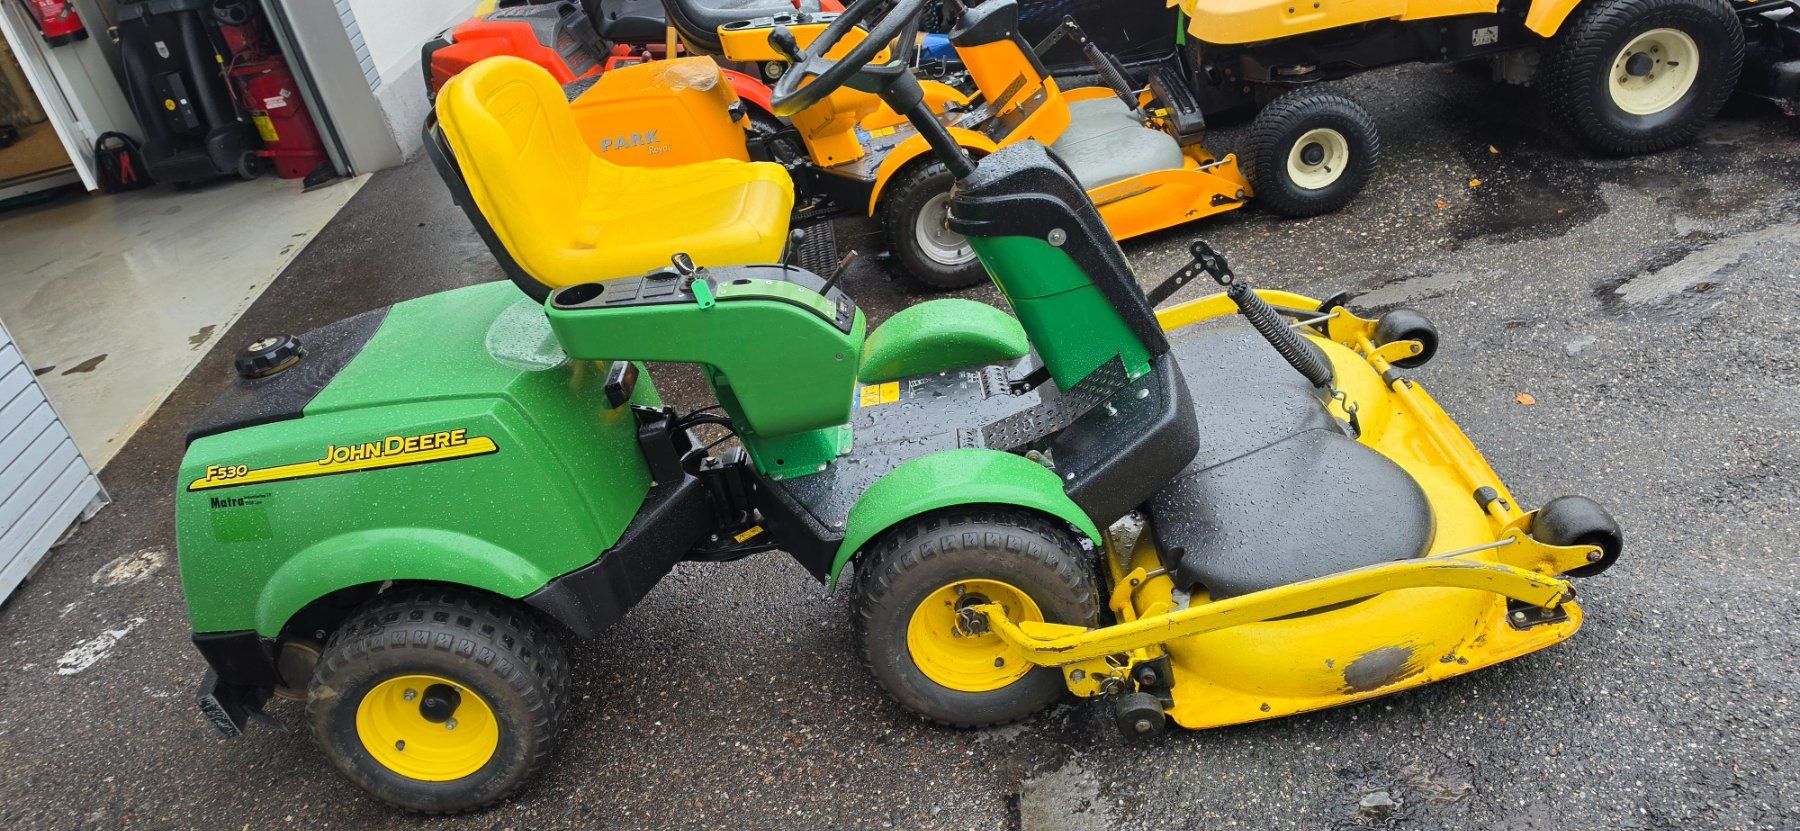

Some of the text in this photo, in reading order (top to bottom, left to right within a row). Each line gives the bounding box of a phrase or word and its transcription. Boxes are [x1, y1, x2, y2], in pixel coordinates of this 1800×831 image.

[600, 129, 660, 152] PARK
[648, 144, 670, 155] Royal
[318, 428, 467, 465] JOHN DEERE
[206, 464, 248, 481] F530
[210, 496, 244, 509] Matra
